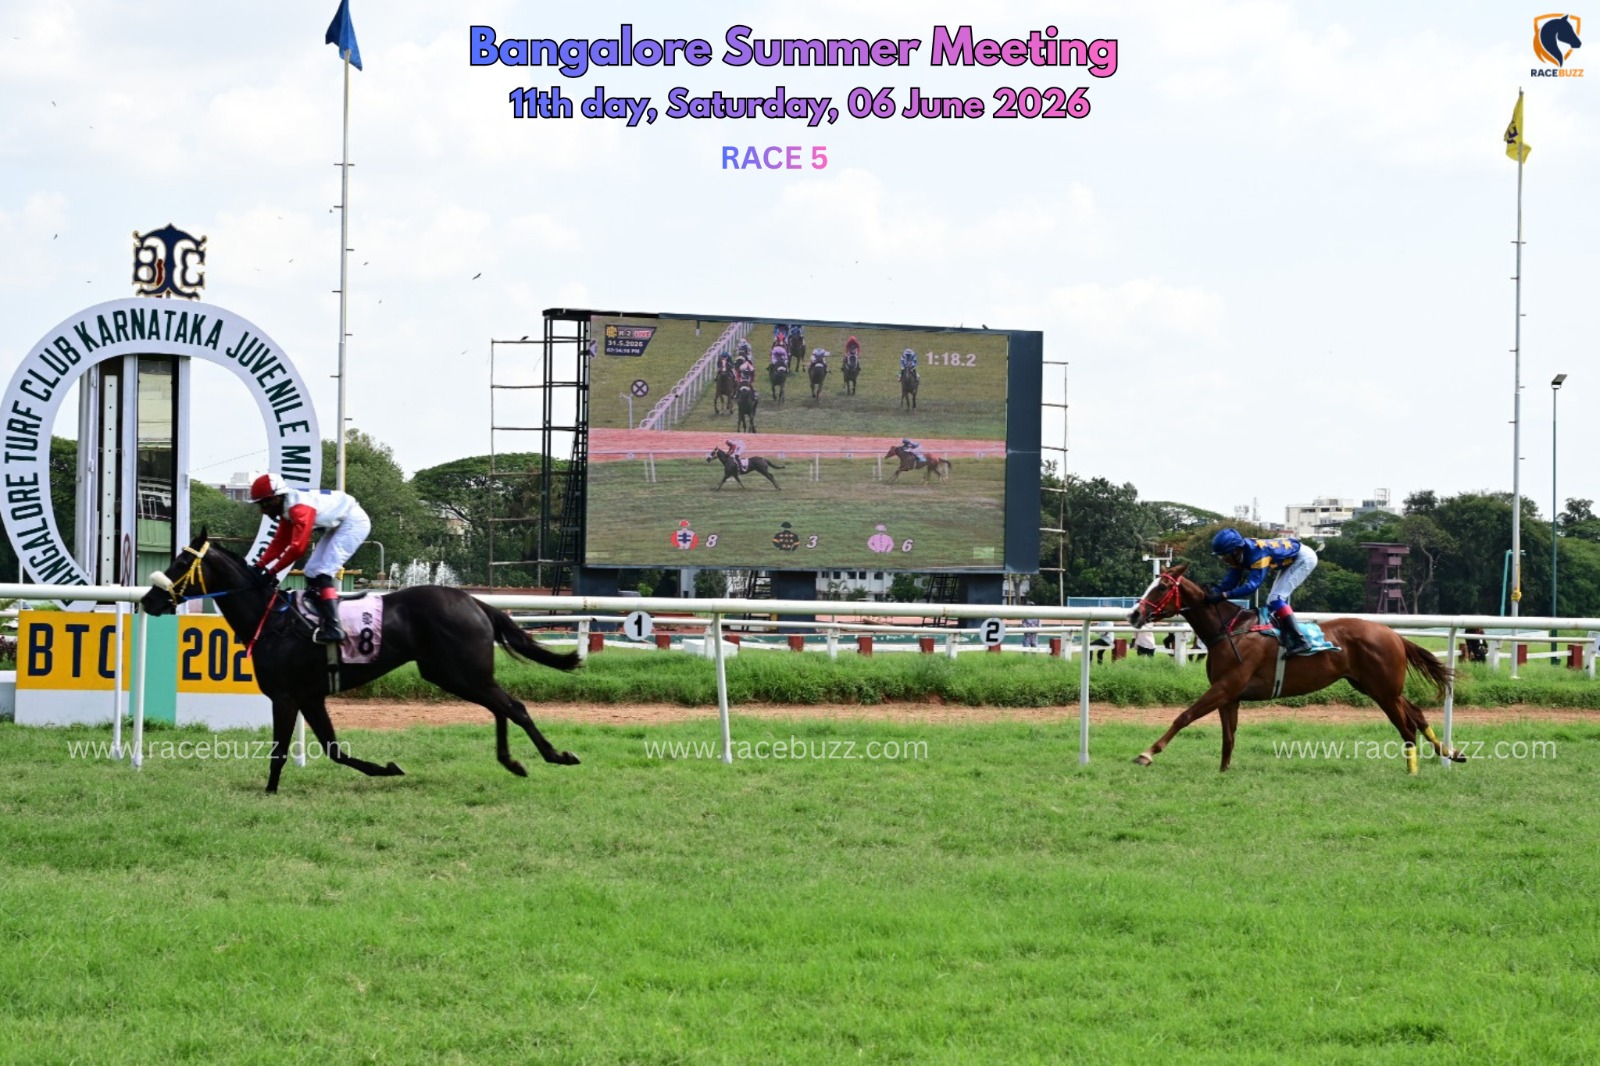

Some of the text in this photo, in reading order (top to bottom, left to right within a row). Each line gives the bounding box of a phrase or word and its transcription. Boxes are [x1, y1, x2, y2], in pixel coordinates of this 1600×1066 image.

[74, 308, 224, 353] KARNATAKA
[20, 336, 81, 402] CLUB
[926, 351, 977, 368] 1:18.2
[226, 331, 311, 437] JUVENILE
[4, 400, 43, 464] TURF
[705, 534, 718, 548] 8
[806, 535, 818, 548] 3
[902, 538, 913, 552] 6
[634, 613, 643, 637] 1
[986, 621, 1000, 643] 2
[182, 626, 253, 682] 202
[359, 627, 374, 655] 8
